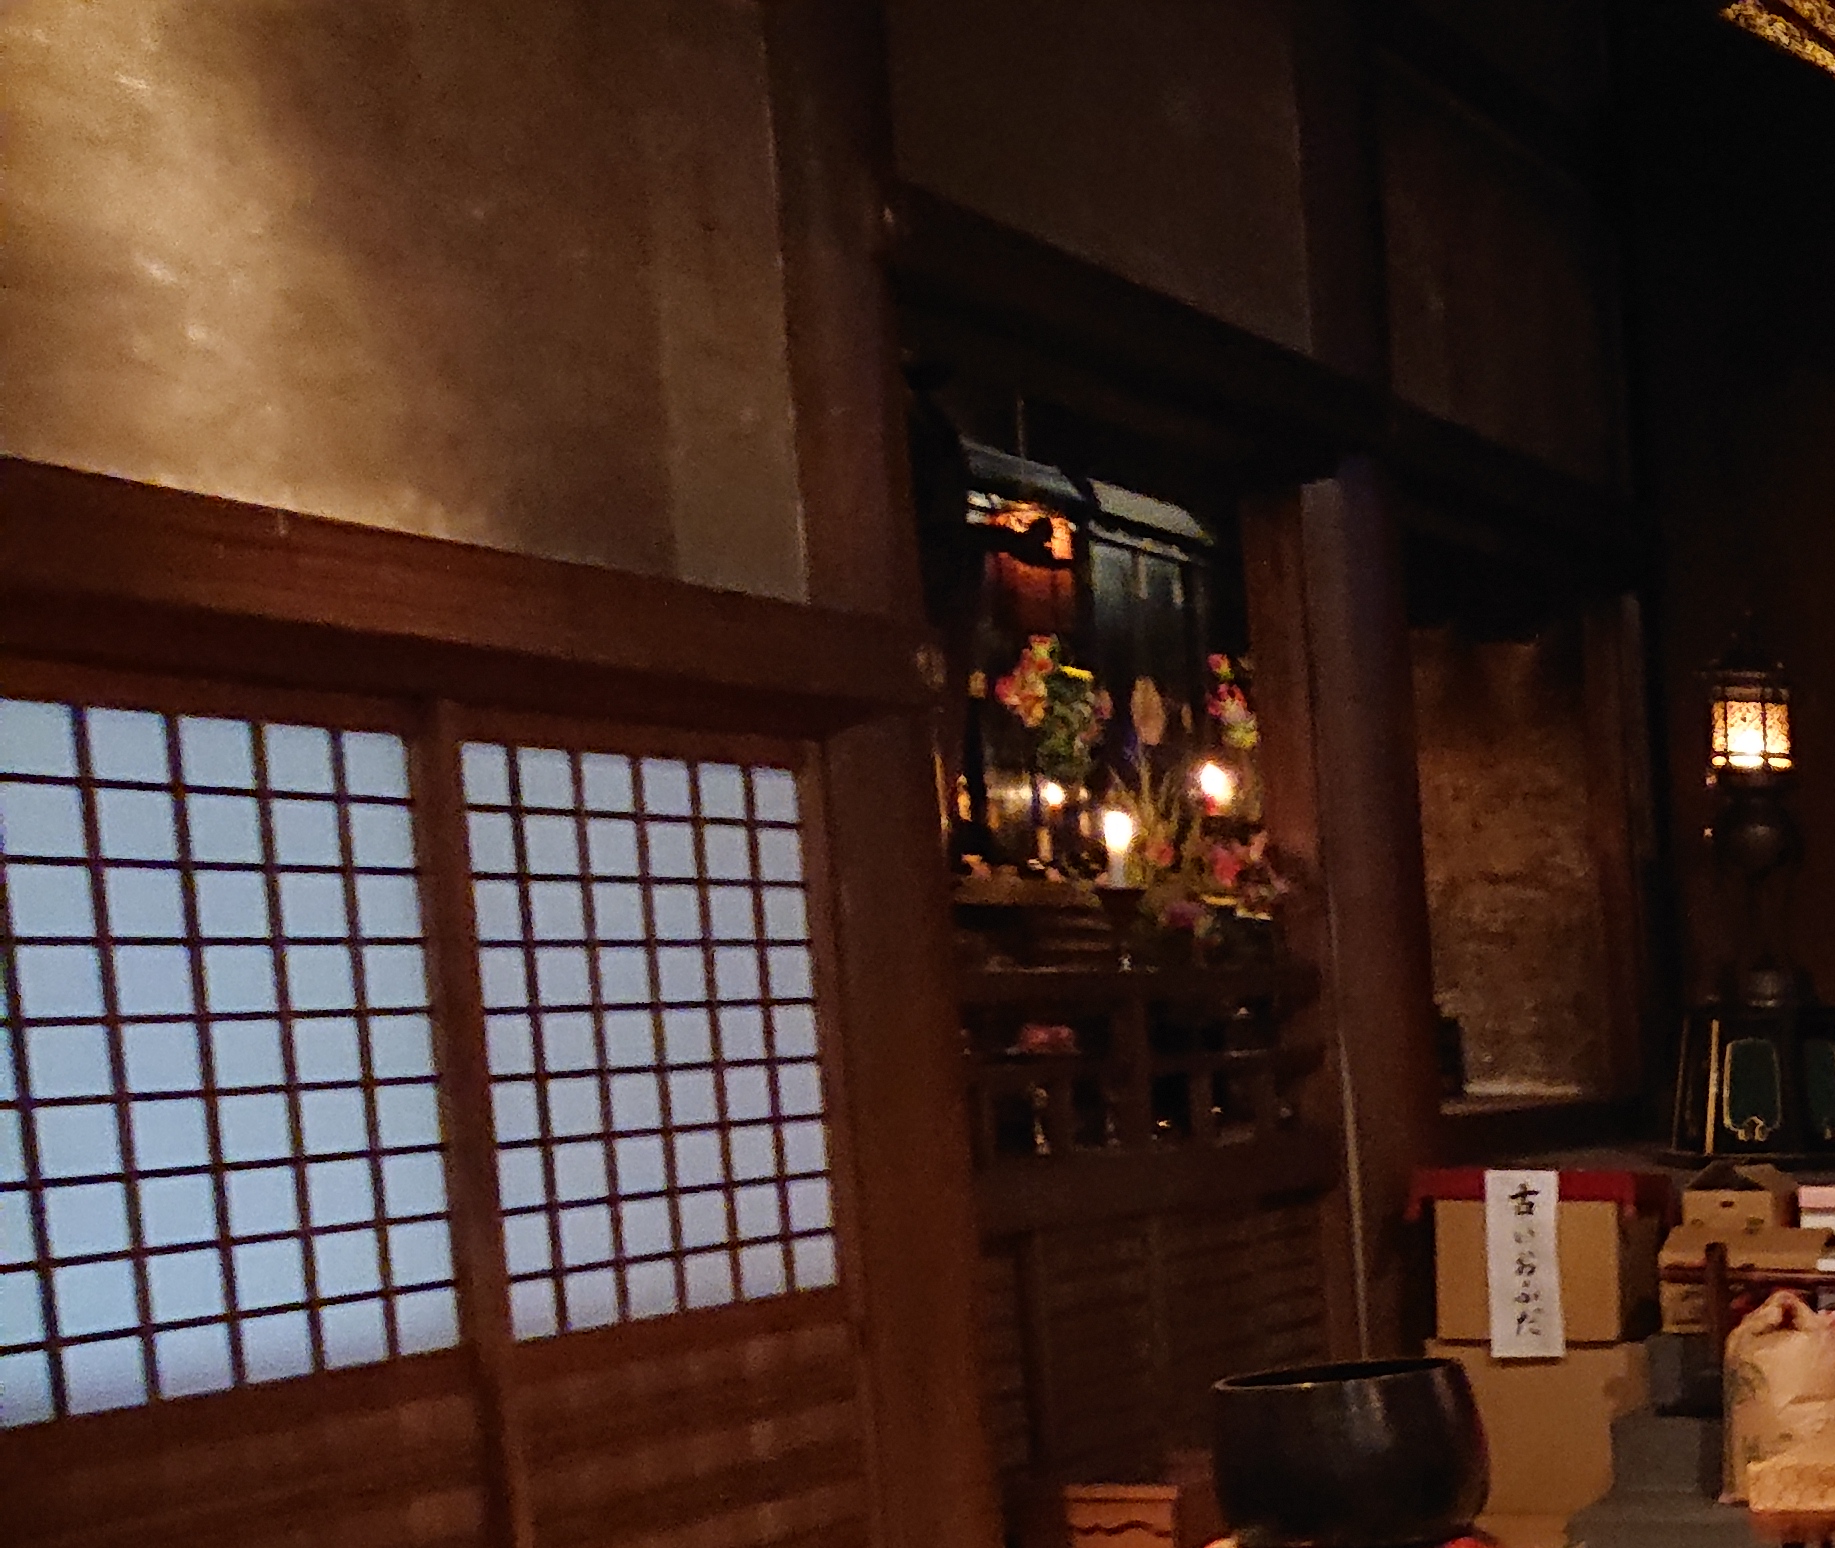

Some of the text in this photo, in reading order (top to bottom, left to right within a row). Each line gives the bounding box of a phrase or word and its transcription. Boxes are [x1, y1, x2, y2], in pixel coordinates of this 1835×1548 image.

[1508, 1182, 1543, 1336] 古いおふだ
